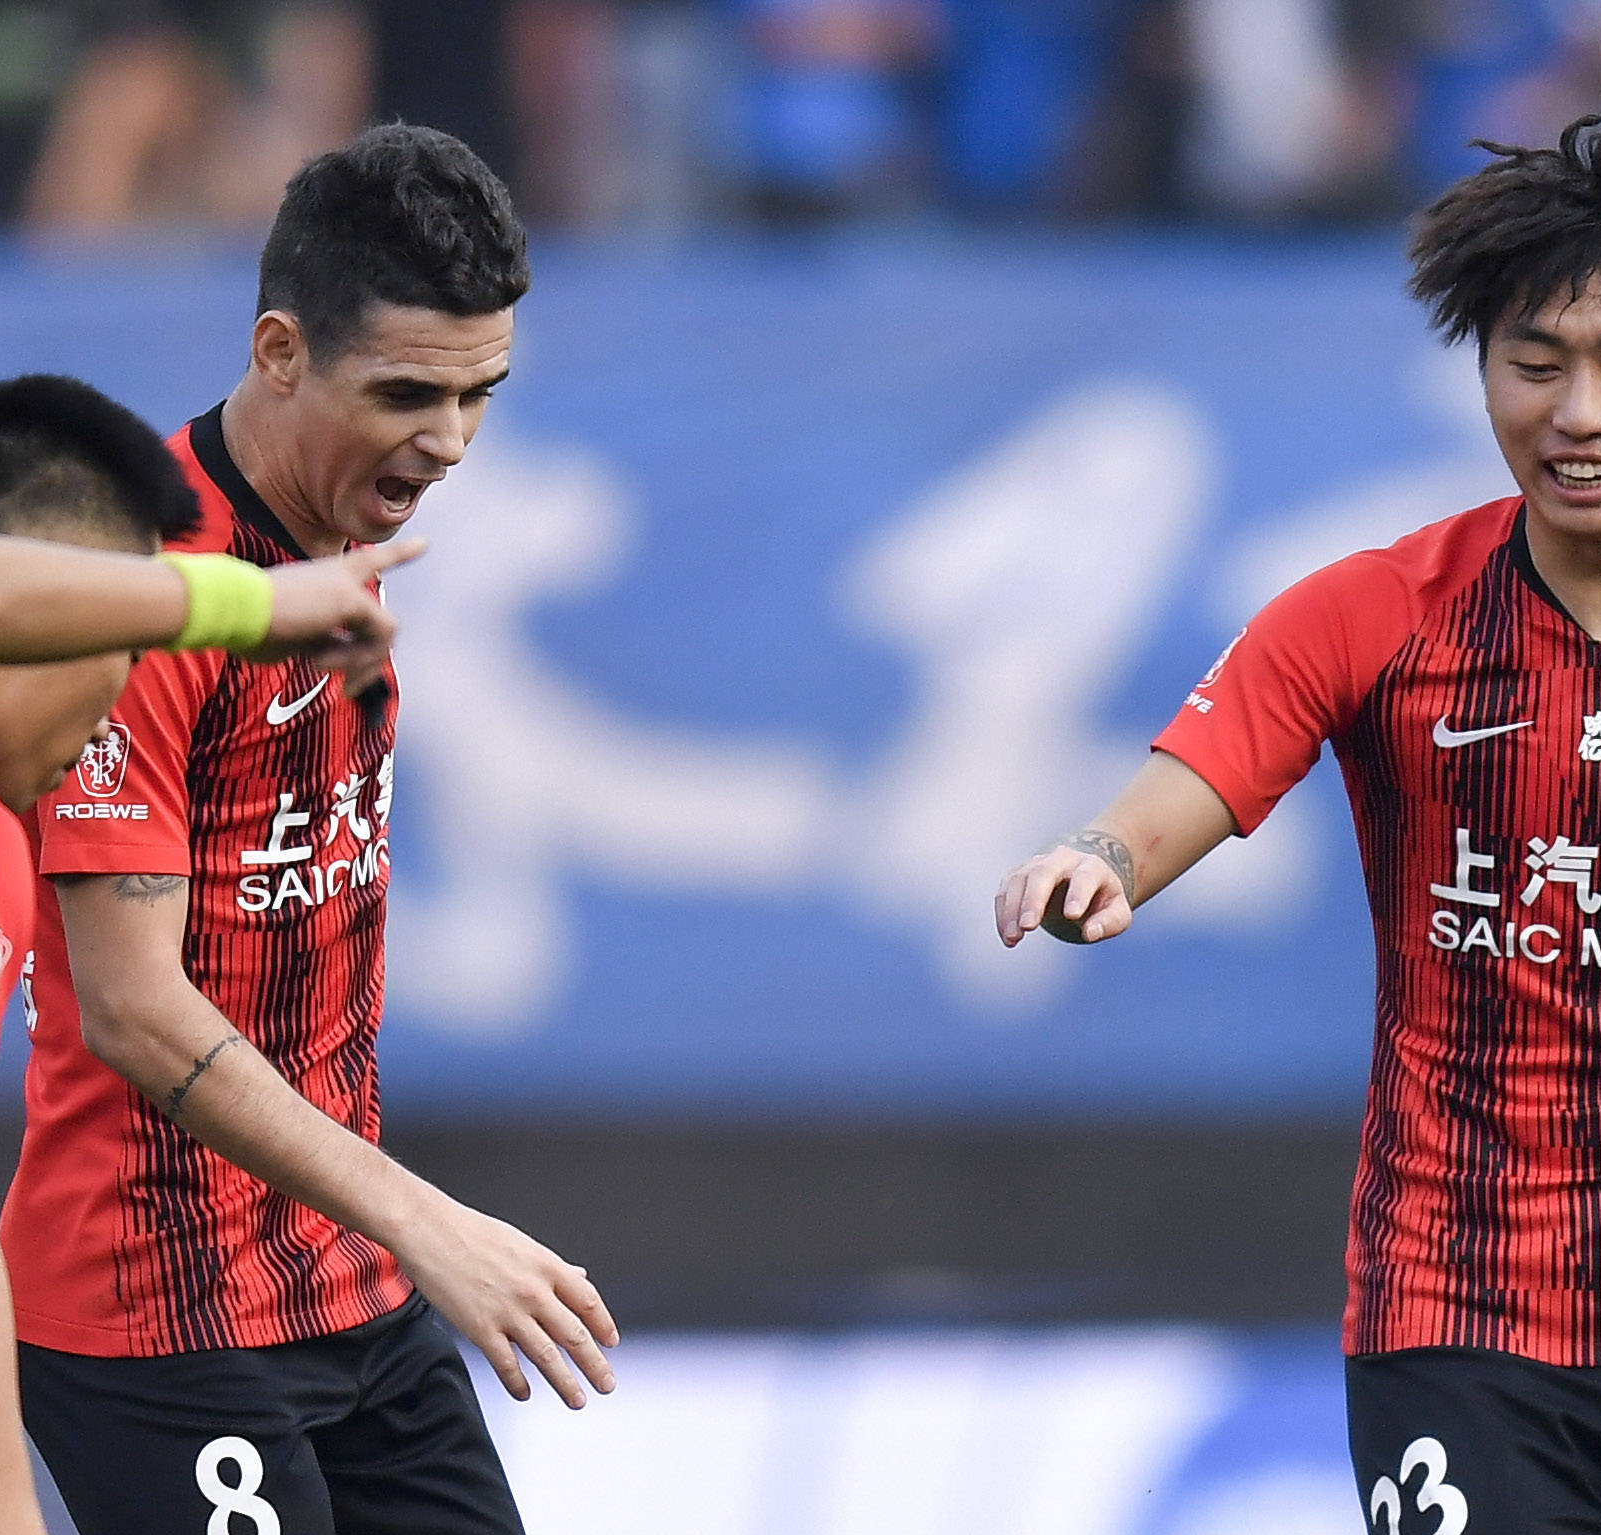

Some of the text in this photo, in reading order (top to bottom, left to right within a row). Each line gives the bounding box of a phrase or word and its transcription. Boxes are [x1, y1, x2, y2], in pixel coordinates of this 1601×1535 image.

[55, 803, 149, 820] ROEWE
[236, 859, 351, 912] SAIC
[1429, 910, 1561, 965] SAIC
